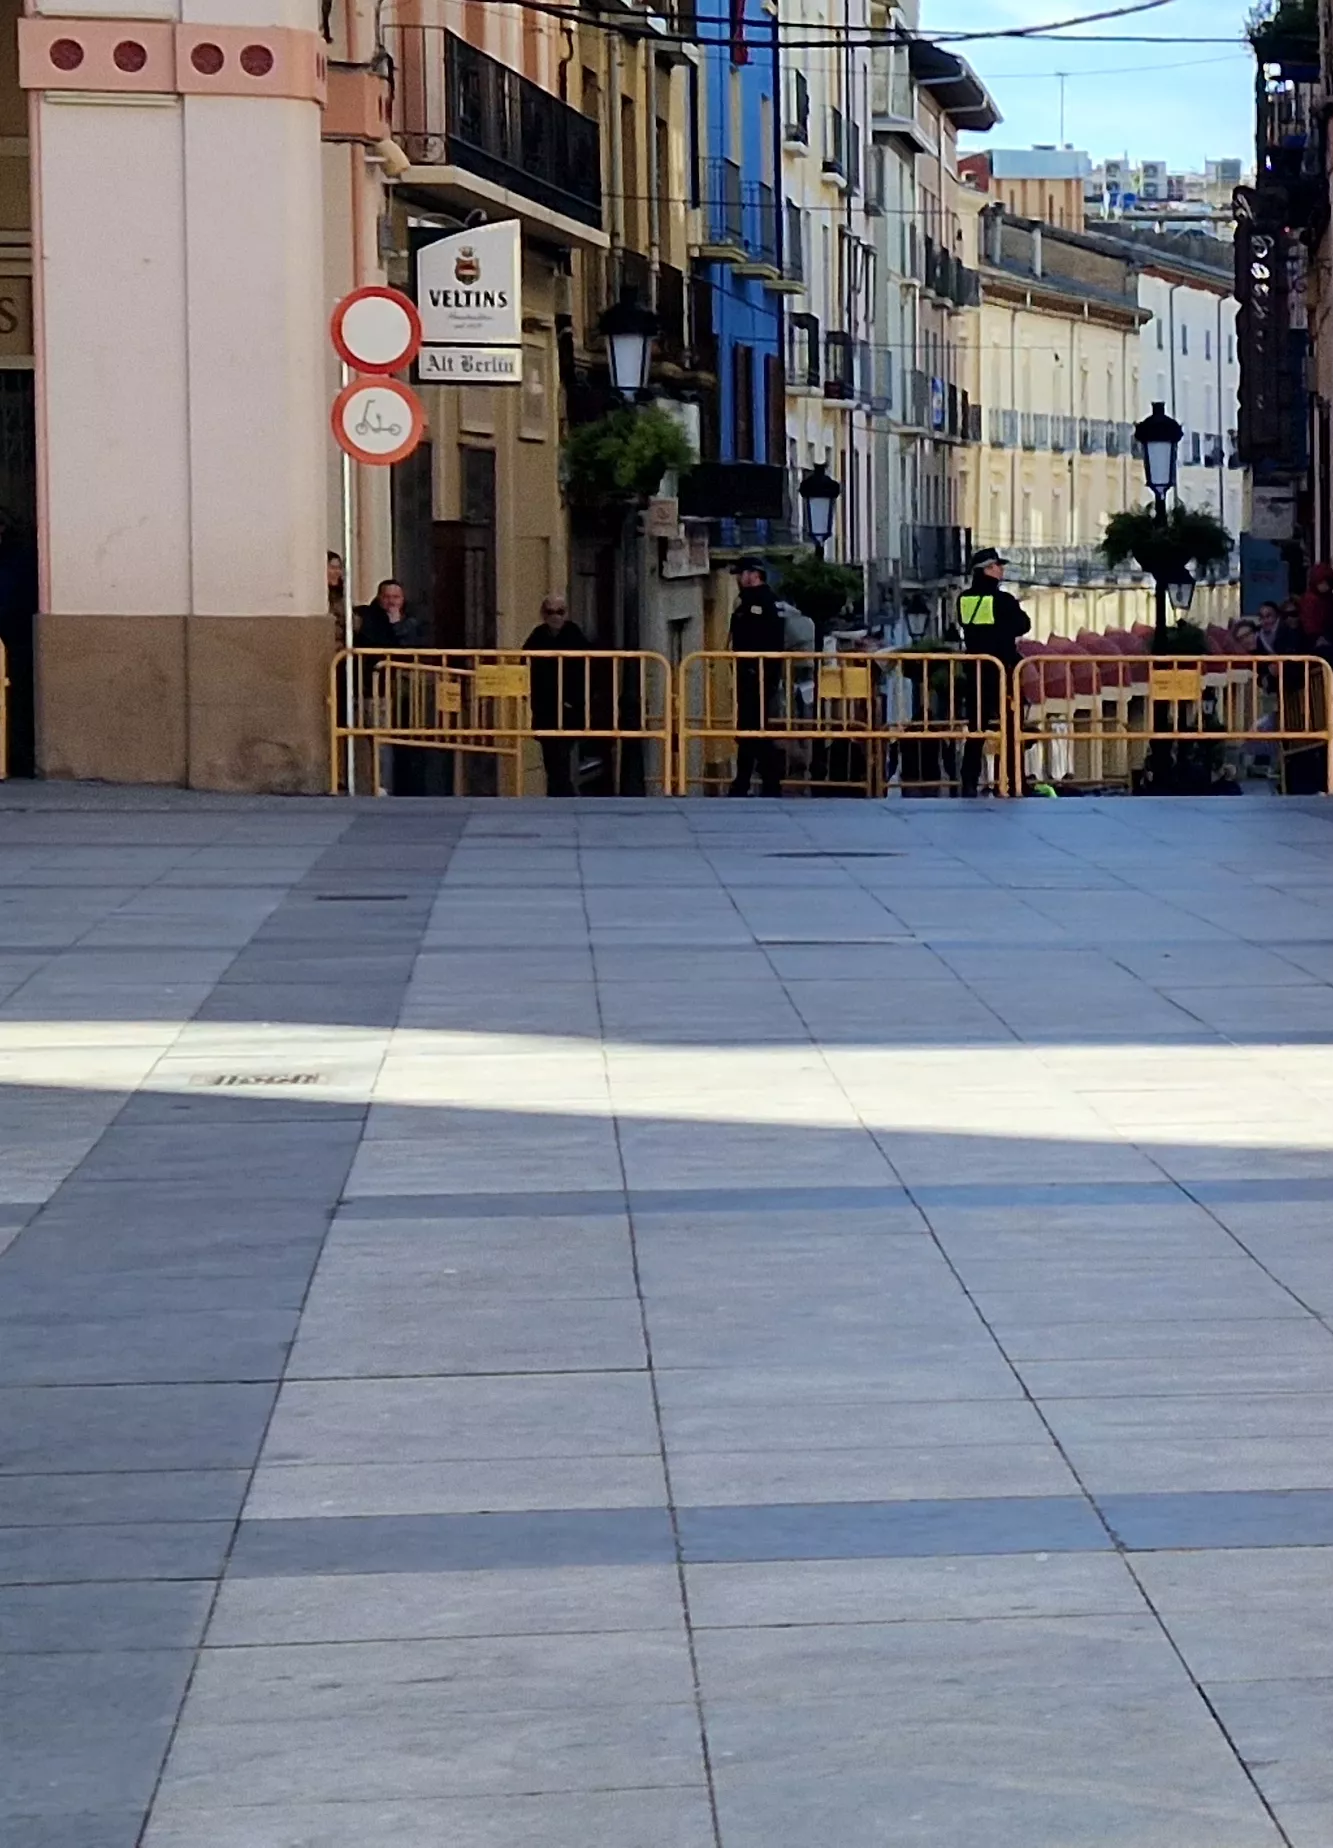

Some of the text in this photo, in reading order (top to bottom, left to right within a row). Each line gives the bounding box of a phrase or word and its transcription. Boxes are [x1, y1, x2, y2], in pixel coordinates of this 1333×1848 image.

[429, 289, 508, 308] VELTINS
[426, 354, 514, 373] Alt Berlin
